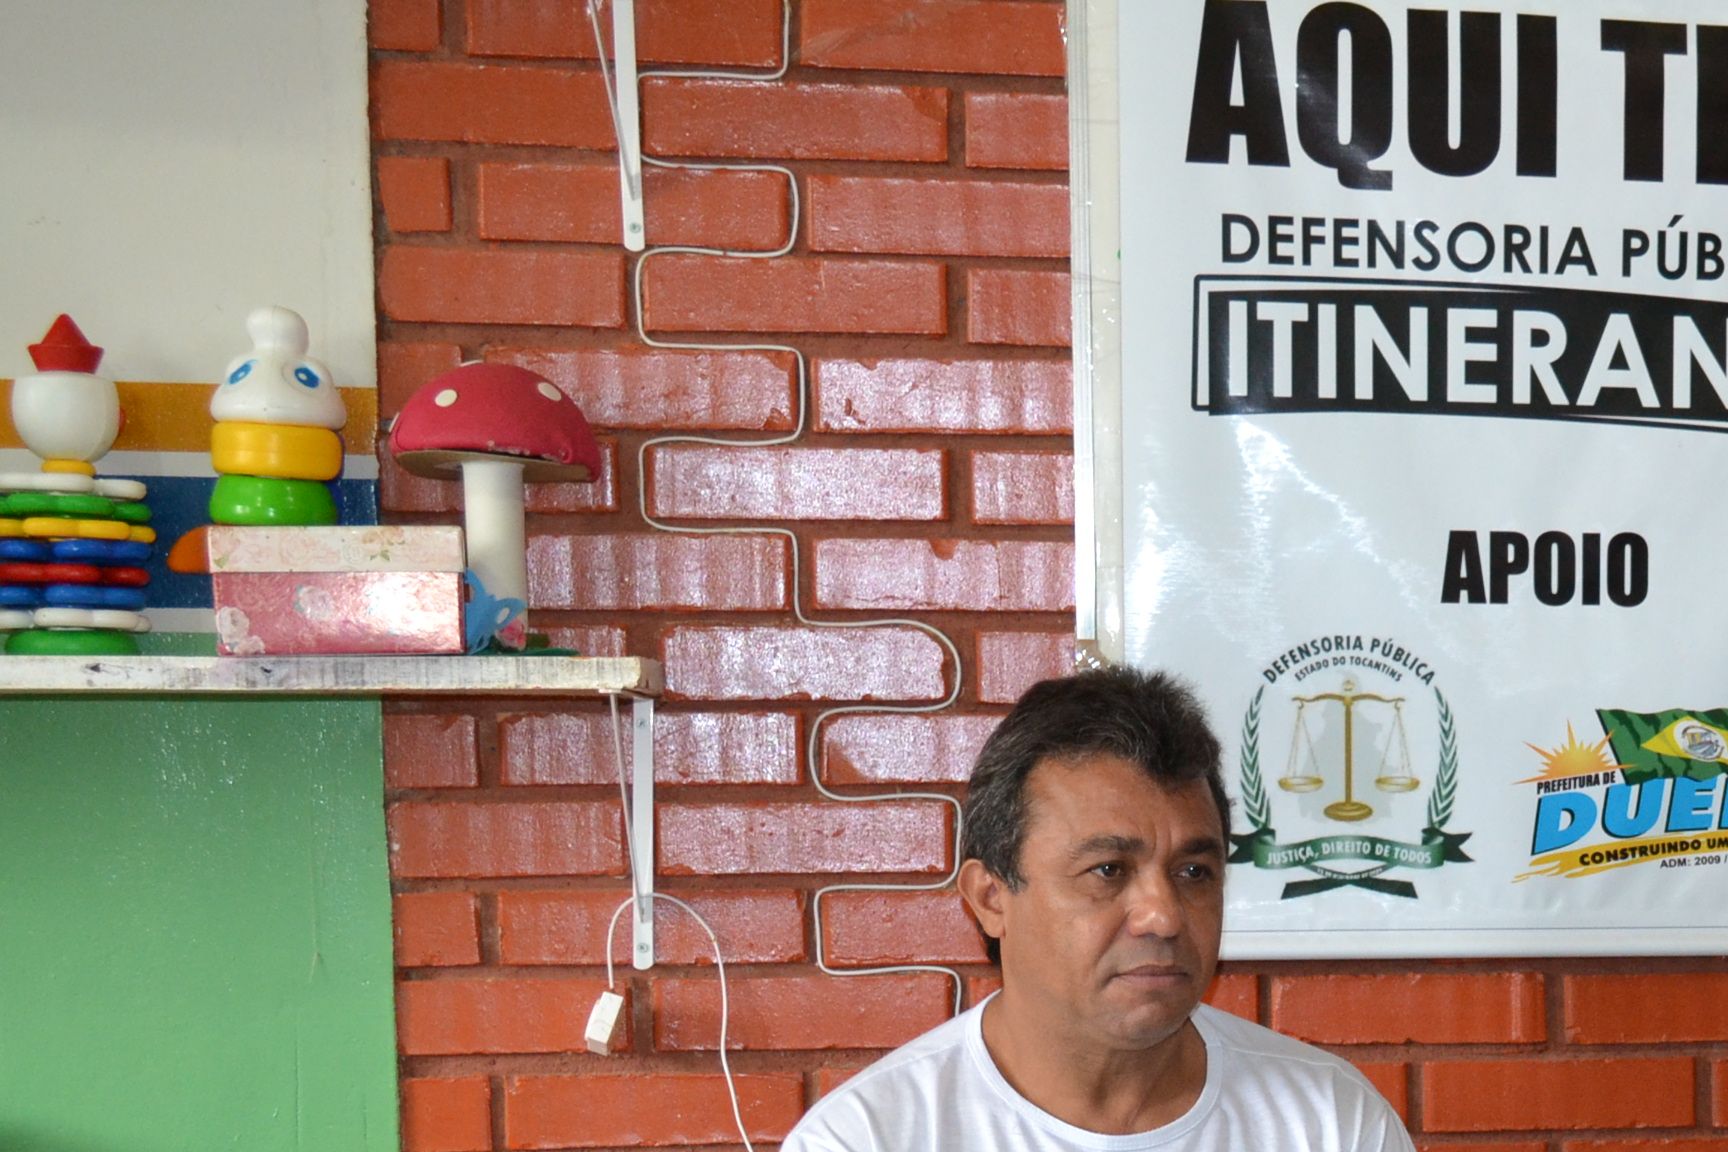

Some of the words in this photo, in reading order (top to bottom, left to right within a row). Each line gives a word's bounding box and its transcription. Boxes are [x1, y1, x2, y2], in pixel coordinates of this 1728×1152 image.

[1186, 0, 1557, 191] AQUI
[1221, 213, 1598, 276] DEFENSORIA
[1440, 530, 1649, 608] APOIO
[1262, 635, 1363, 684] DEFENSORIA
[1370, 638, 1435, 686] PÚBLICA
[1294, 658, 1329, 682] ESTADO
[1332, 655, 1346, 669] DO
[1349, 655, 1403, 682] TOCANTINS
[1537, 773, 1601, 794] PREFEITURA
[1602, 770, 1616, 785] DE
[1266, 845, 1319, 865] JUSTIÇA,
[1321, 841, 1371, 855] DIREITO
[1374, 842, 1390, 854] DE
[1393, 846, 1432, 864] TODOS
[1579, 838, 1702, 867] CONSTRUINDO
[1659, 856, 1691, 869] ADM:
[1694, 854, 1721, 866] 2009
